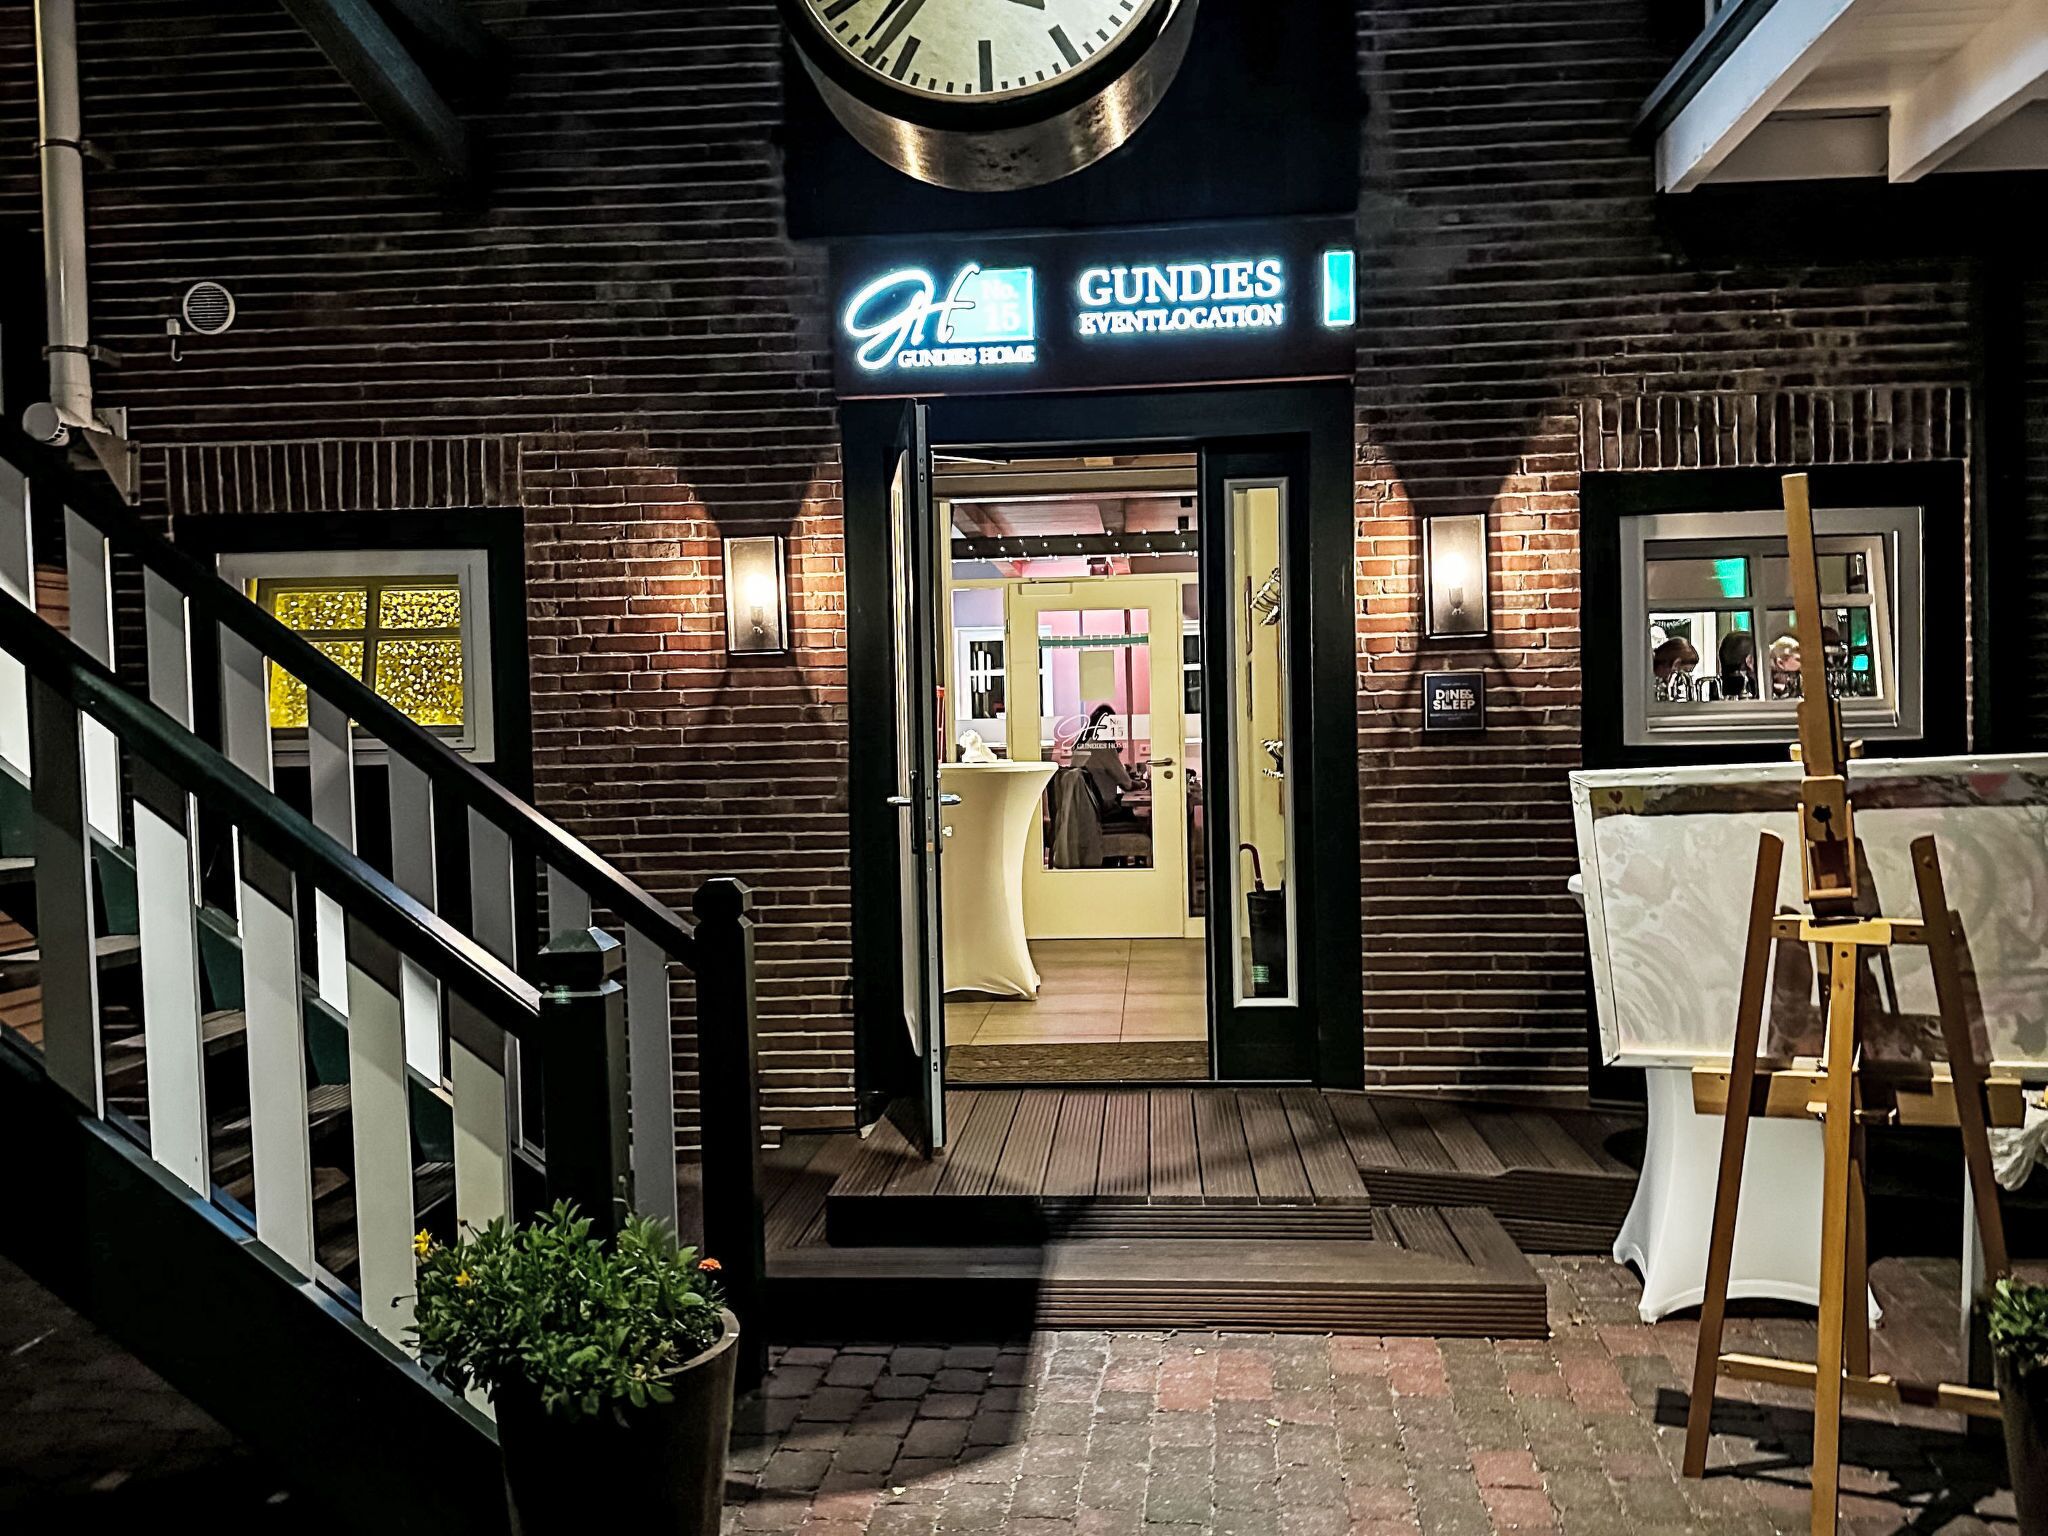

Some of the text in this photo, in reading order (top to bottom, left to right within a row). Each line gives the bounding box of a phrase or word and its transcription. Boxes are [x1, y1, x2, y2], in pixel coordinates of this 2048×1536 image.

[1079, 260, 1282, 306] GUNDIES
[1079, 303, 1285, 334] EVENTLOCATION
[898, 345, 1035, 368] GUNDIES HOME
[1433, 699, 1475, 710] SLEEP
